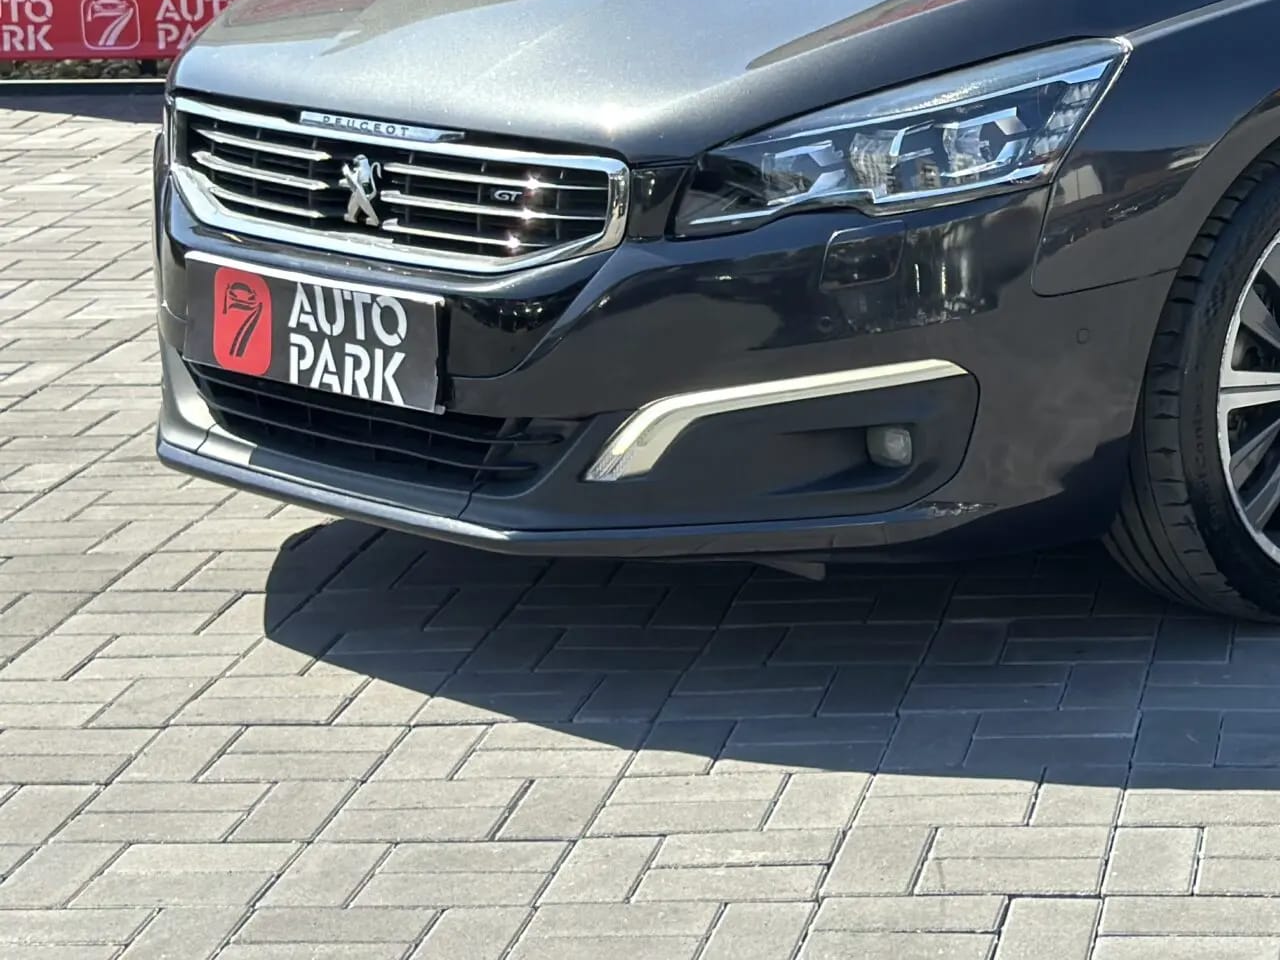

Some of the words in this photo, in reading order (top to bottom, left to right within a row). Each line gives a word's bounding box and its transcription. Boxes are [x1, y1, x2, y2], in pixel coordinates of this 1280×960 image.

[322, 115, 410, 137] PEUGEOT
[494, 189, 523, 203] GT
[288, 281, 407, 347] AUTO
[289, 334, 407, 406] PARK
